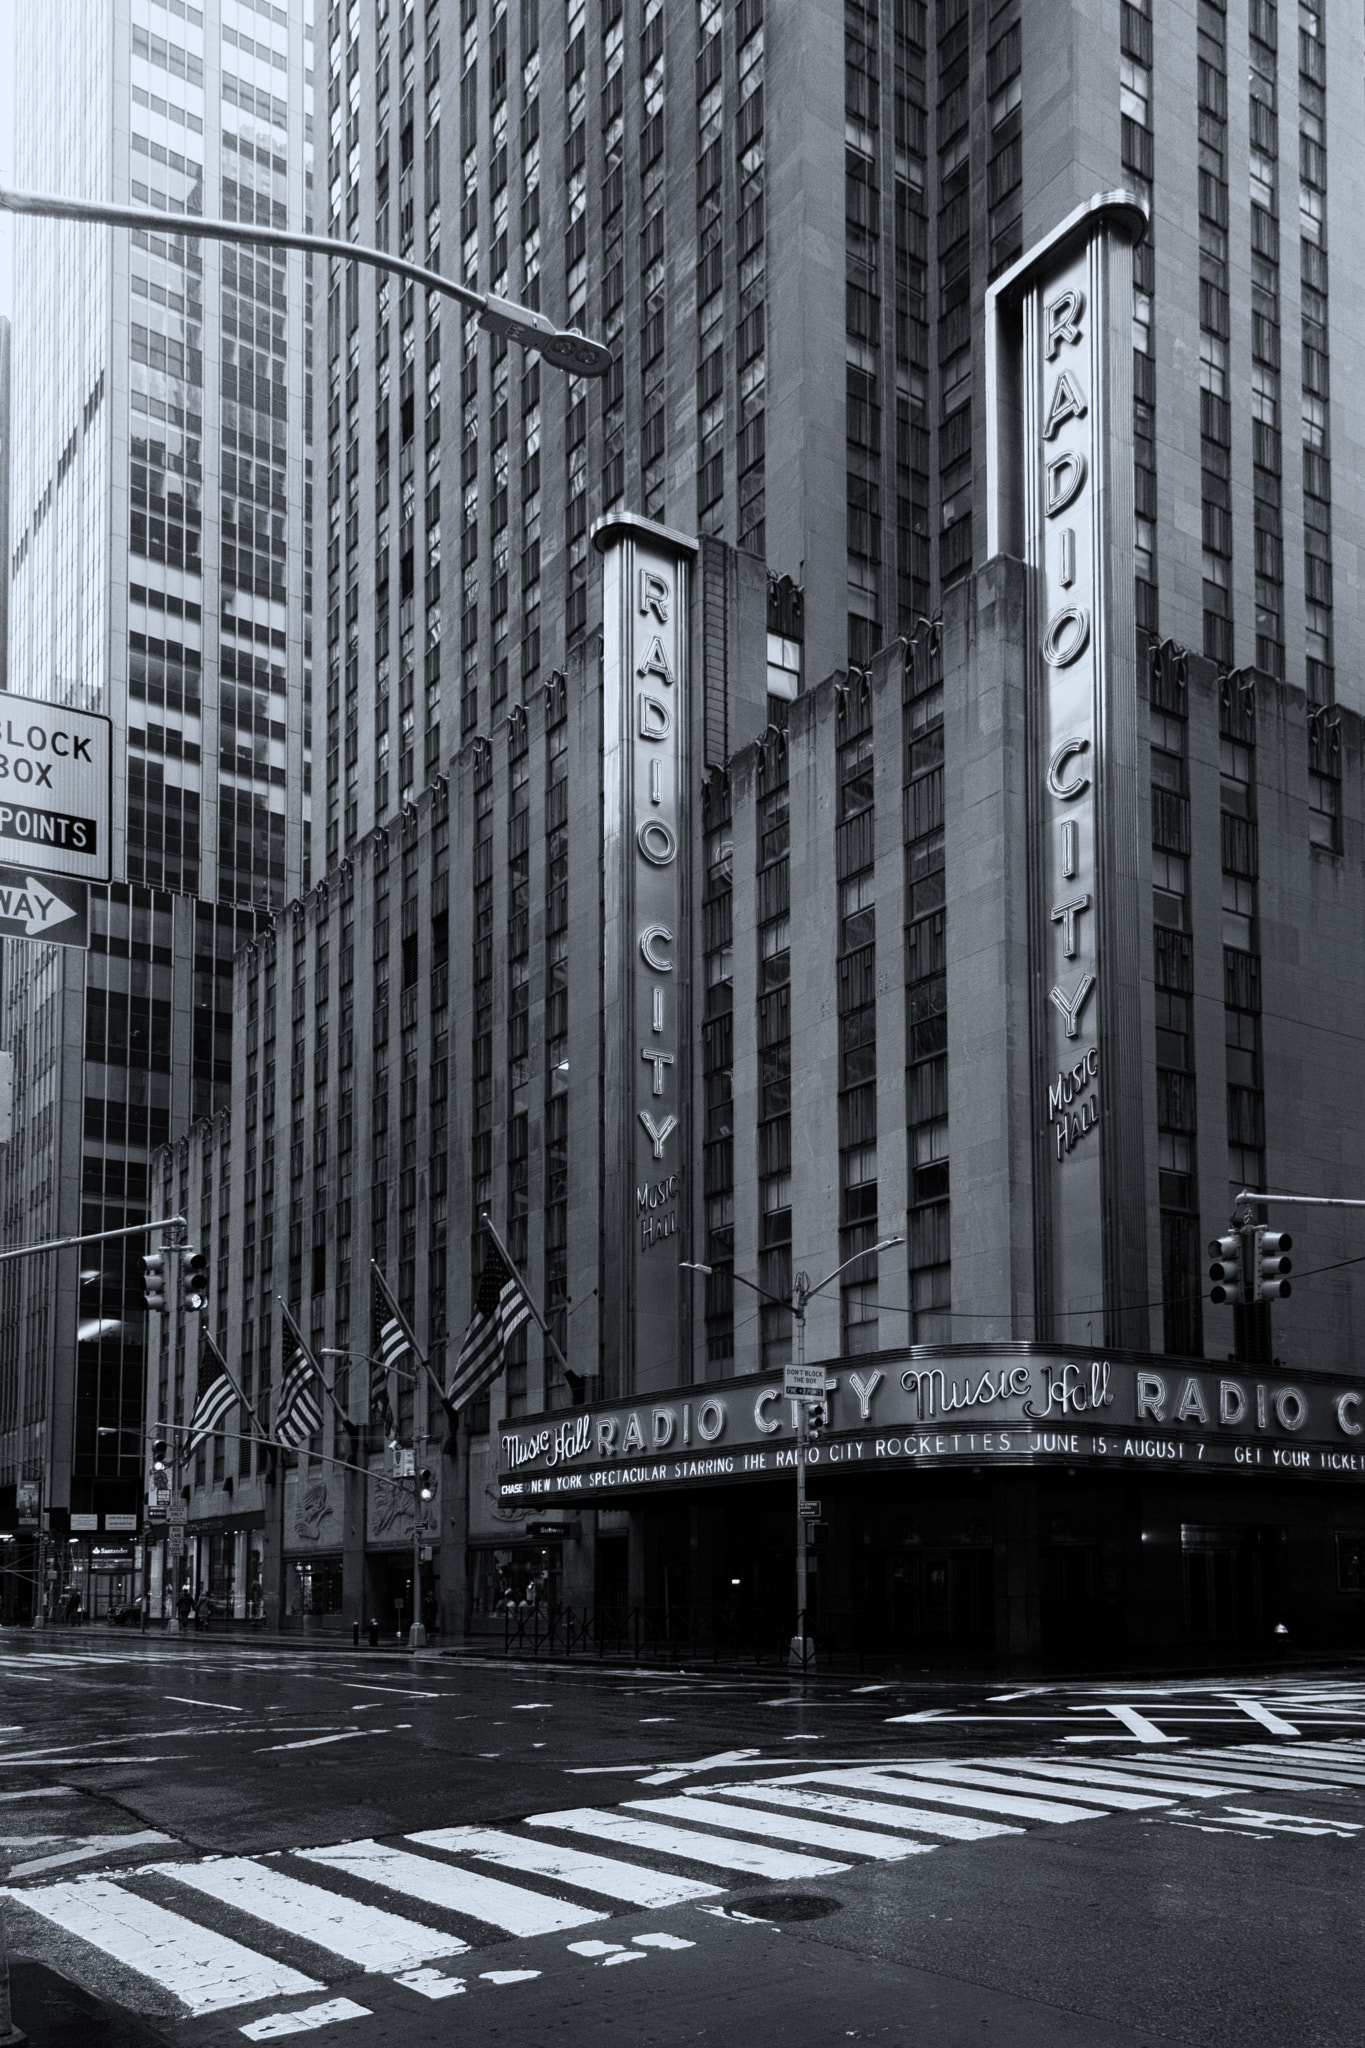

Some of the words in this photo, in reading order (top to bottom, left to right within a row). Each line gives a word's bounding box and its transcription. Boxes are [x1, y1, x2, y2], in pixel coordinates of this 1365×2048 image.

[1043, 289, 1090, 668] RADIO
[0, 720, 92, 763] LOCK
[637, 568, 677, 865] RADIO
[0, 806, 87, 847] POINTS
[1046, 737, 1096, 1038] CITY
[639, 924, 677, 1158] CITY
[1048, 1049, 1098, 1121] MUSIC
[1056, 1096, 1099, 1160] HALL
[642, 1212, 678, 1250] HALL
[502, 1430, 550, 1469] Music
[545, 1414, 592, 1467] Hall
[597, 1399, 727, 1455] RADIO
[901, 1367, 1031, 1419] Music
[1024, 1362, 1114, 1418] Hall
[1137, 1372, 1307, 1431] RADIO
[501, 1483, 523, 1495] CHASE
[531, 1478, 551, 1493] NEW
[557, 1475, 582, 1491] YORK
[589, 1464, 667, 1487] SPECTACULAR
[675, 1457, 734, 1478] STARRING
[744, 1453, 766, 1469] THE
[830, 1441, 864, 1461] CITY
[875, 1433, 1011, 1457] ROCKETTES
[1030, 1433, 1080, 1453] JUNE
[1092, 1437, 1107, 1454] 15
[1124, 1438, 1185, 1459] AUGUST
[1196, 1443, 1205, 1460] 7
[1234, 1446, 1262, 1464] GET
[1272, 1449, 1310, 1467] YOUR
[1319, 1452, 1365, 1470] TICKET
[101, 1547, 128, 1555] Santander
[540, 1526, 565, 1535] Subway
